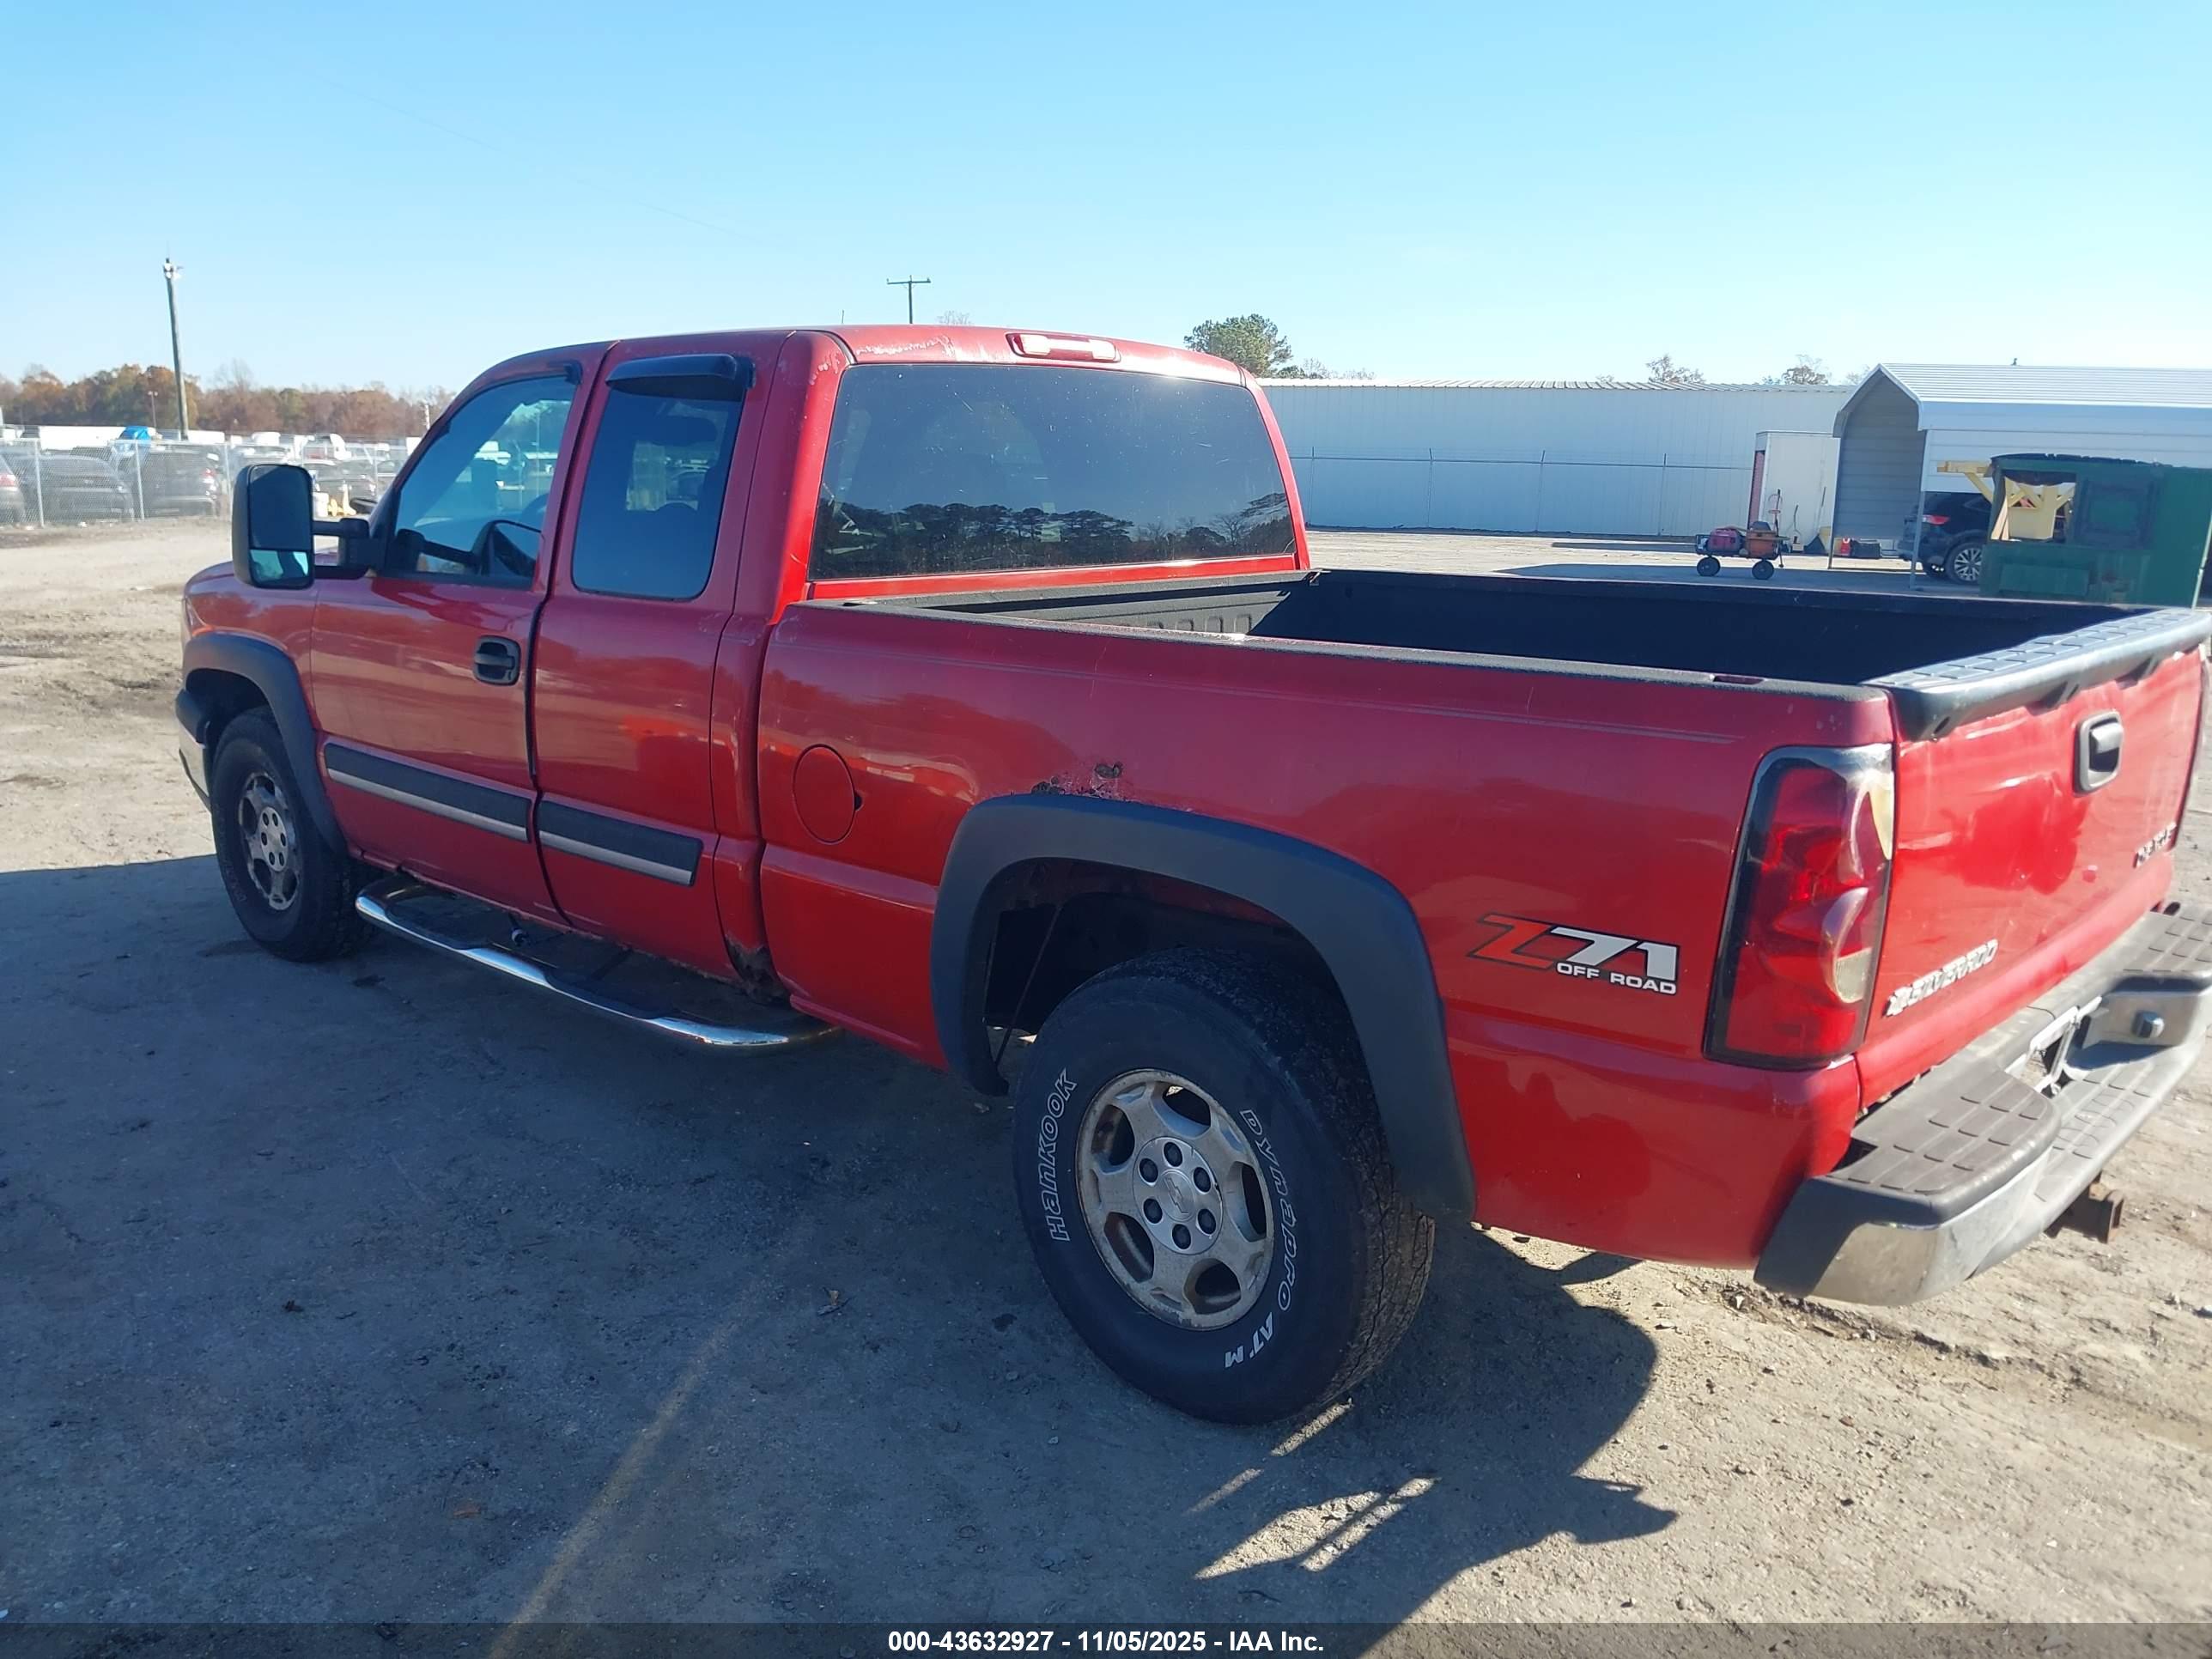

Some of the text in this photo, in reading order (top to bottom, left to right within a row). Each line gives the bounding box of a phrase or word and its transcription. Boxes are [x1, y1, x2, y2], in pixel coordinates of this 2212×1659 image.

[1467, 912, 1680, 981] Z71
[1556, 962, 1677, 995] OFF ROAD
